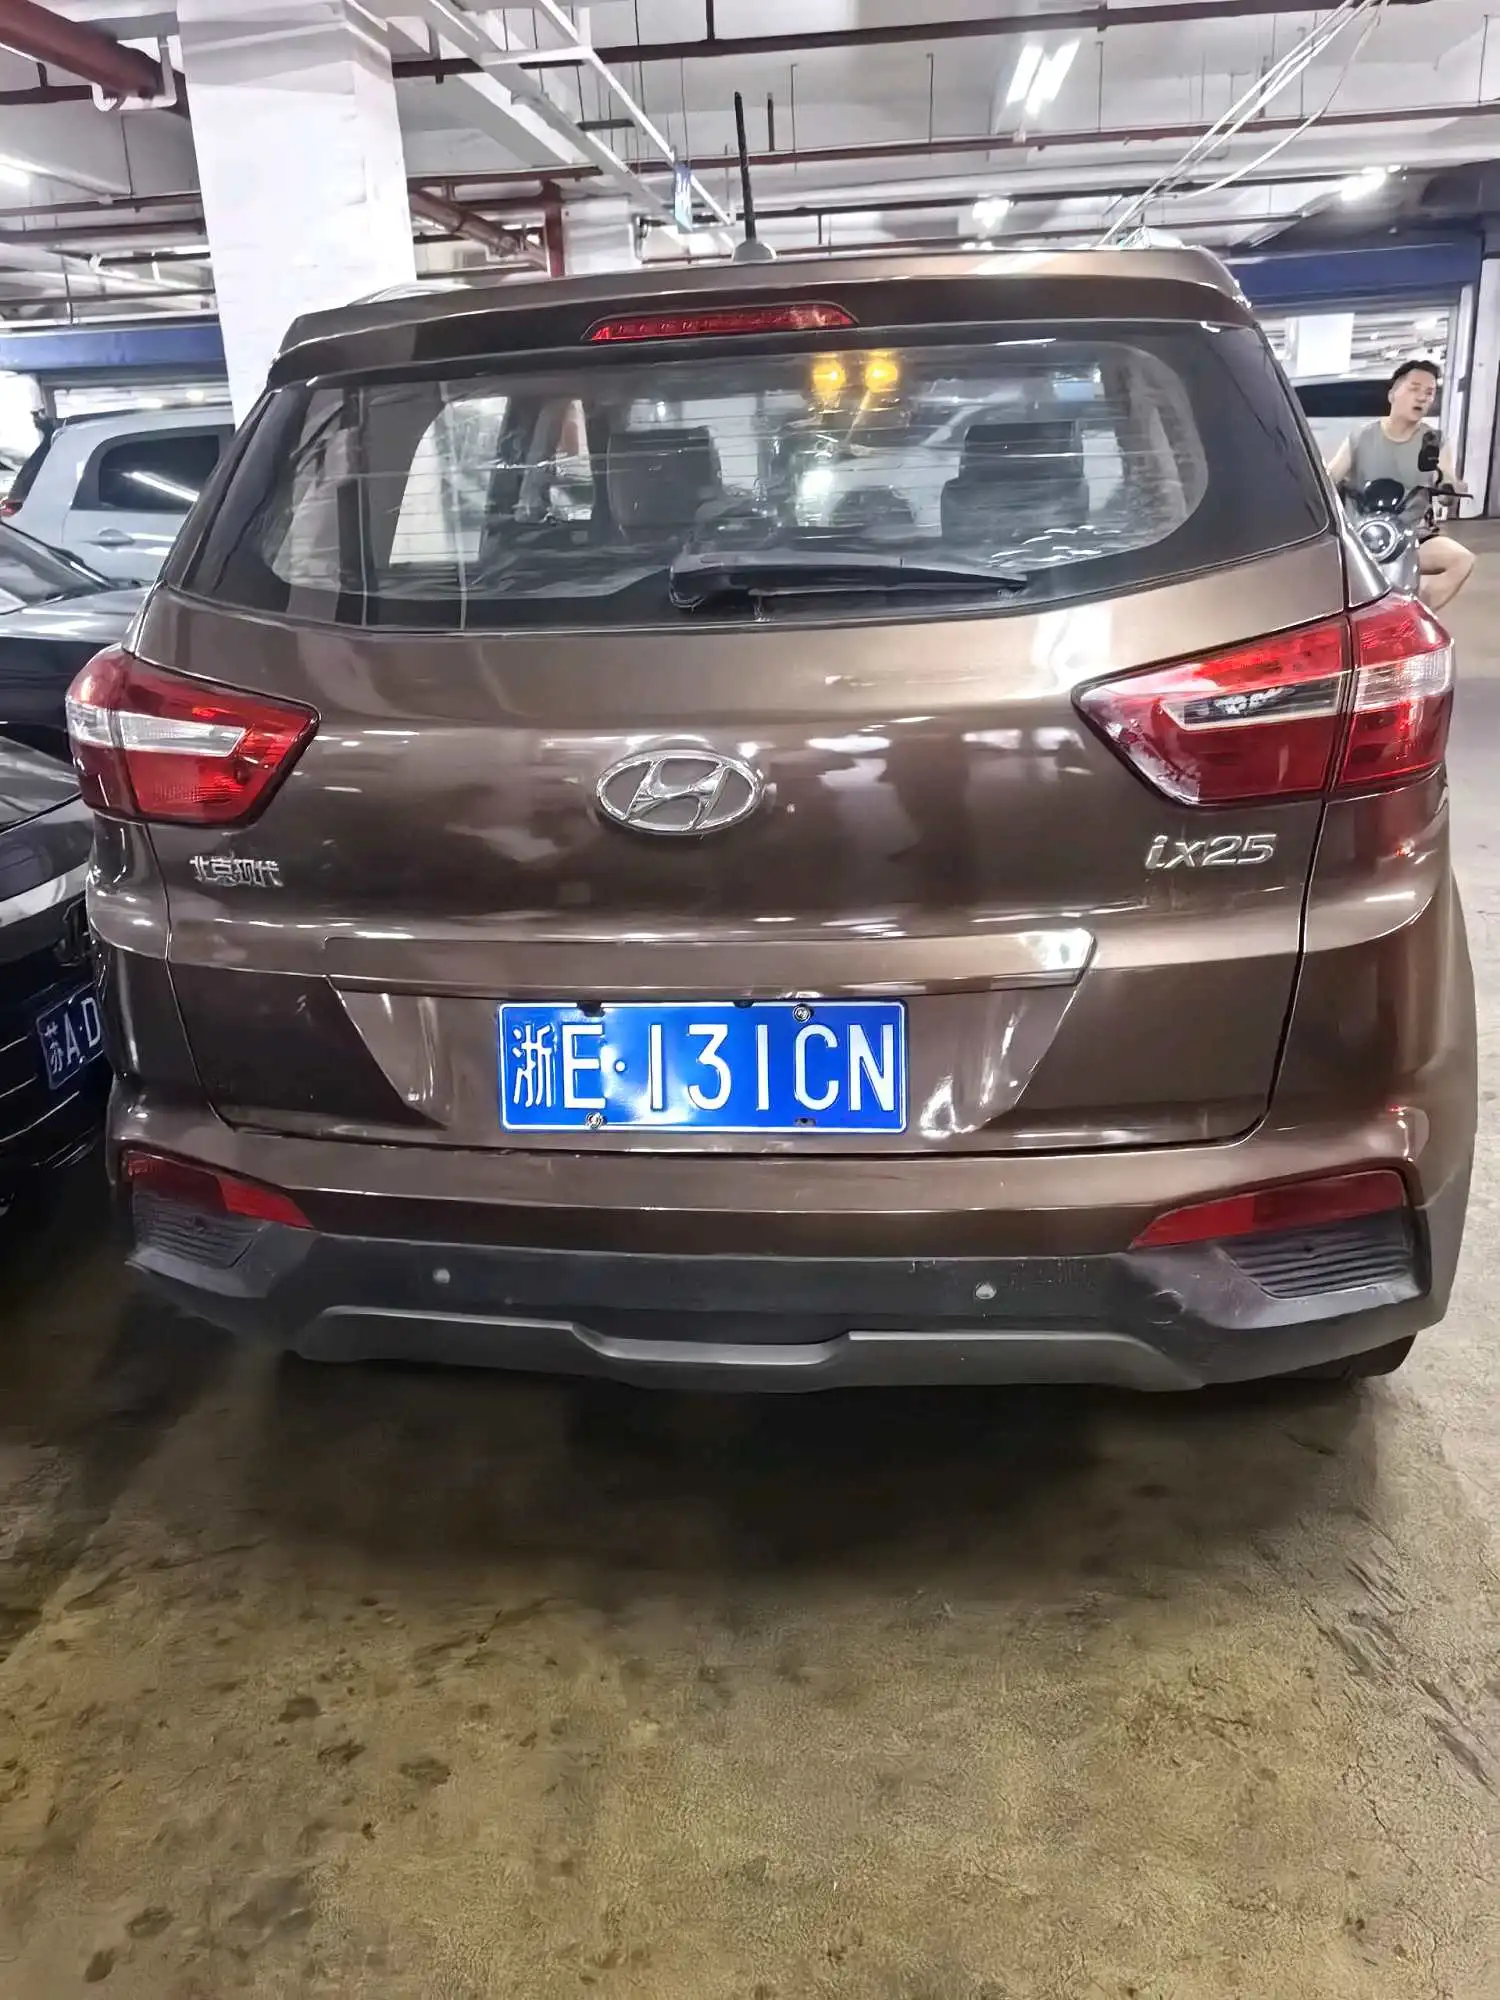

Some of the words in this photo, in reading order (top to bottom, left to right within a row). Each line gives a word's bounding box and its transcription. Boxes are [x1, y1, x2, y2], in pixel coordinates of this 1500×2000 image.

[1145, 834, 1277, 869] ix25
[189, 855, 285, 887] 北京现代
